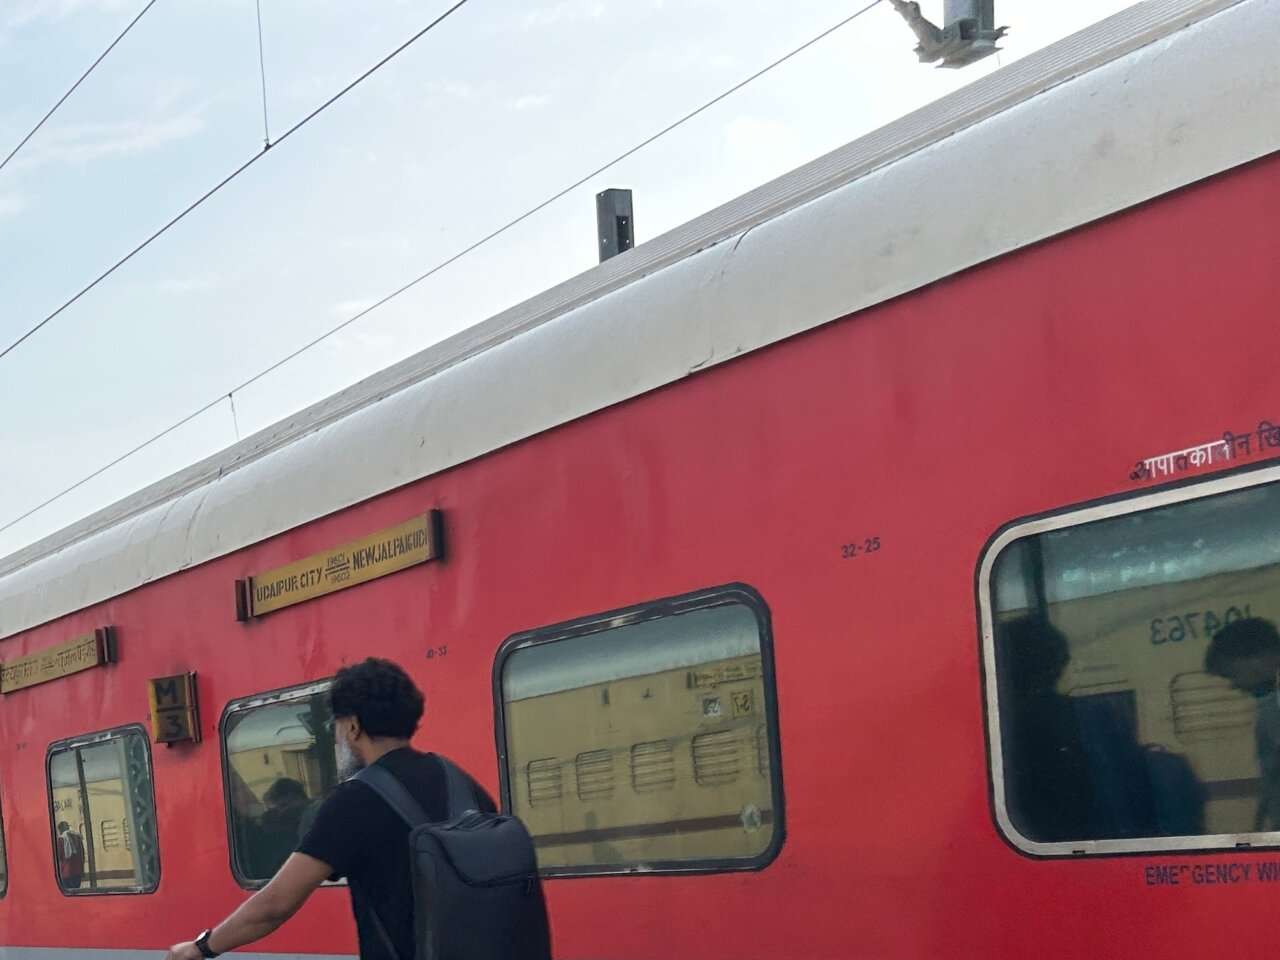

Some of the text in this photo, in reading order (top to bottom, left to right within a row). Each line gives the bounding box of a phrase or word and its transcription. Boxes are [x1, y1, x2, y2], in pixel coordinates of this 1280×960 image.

[841, 537, 881, 560] 32-25
[300, 567, 322, 588] CITY
[155, 680, 177, 705] M
